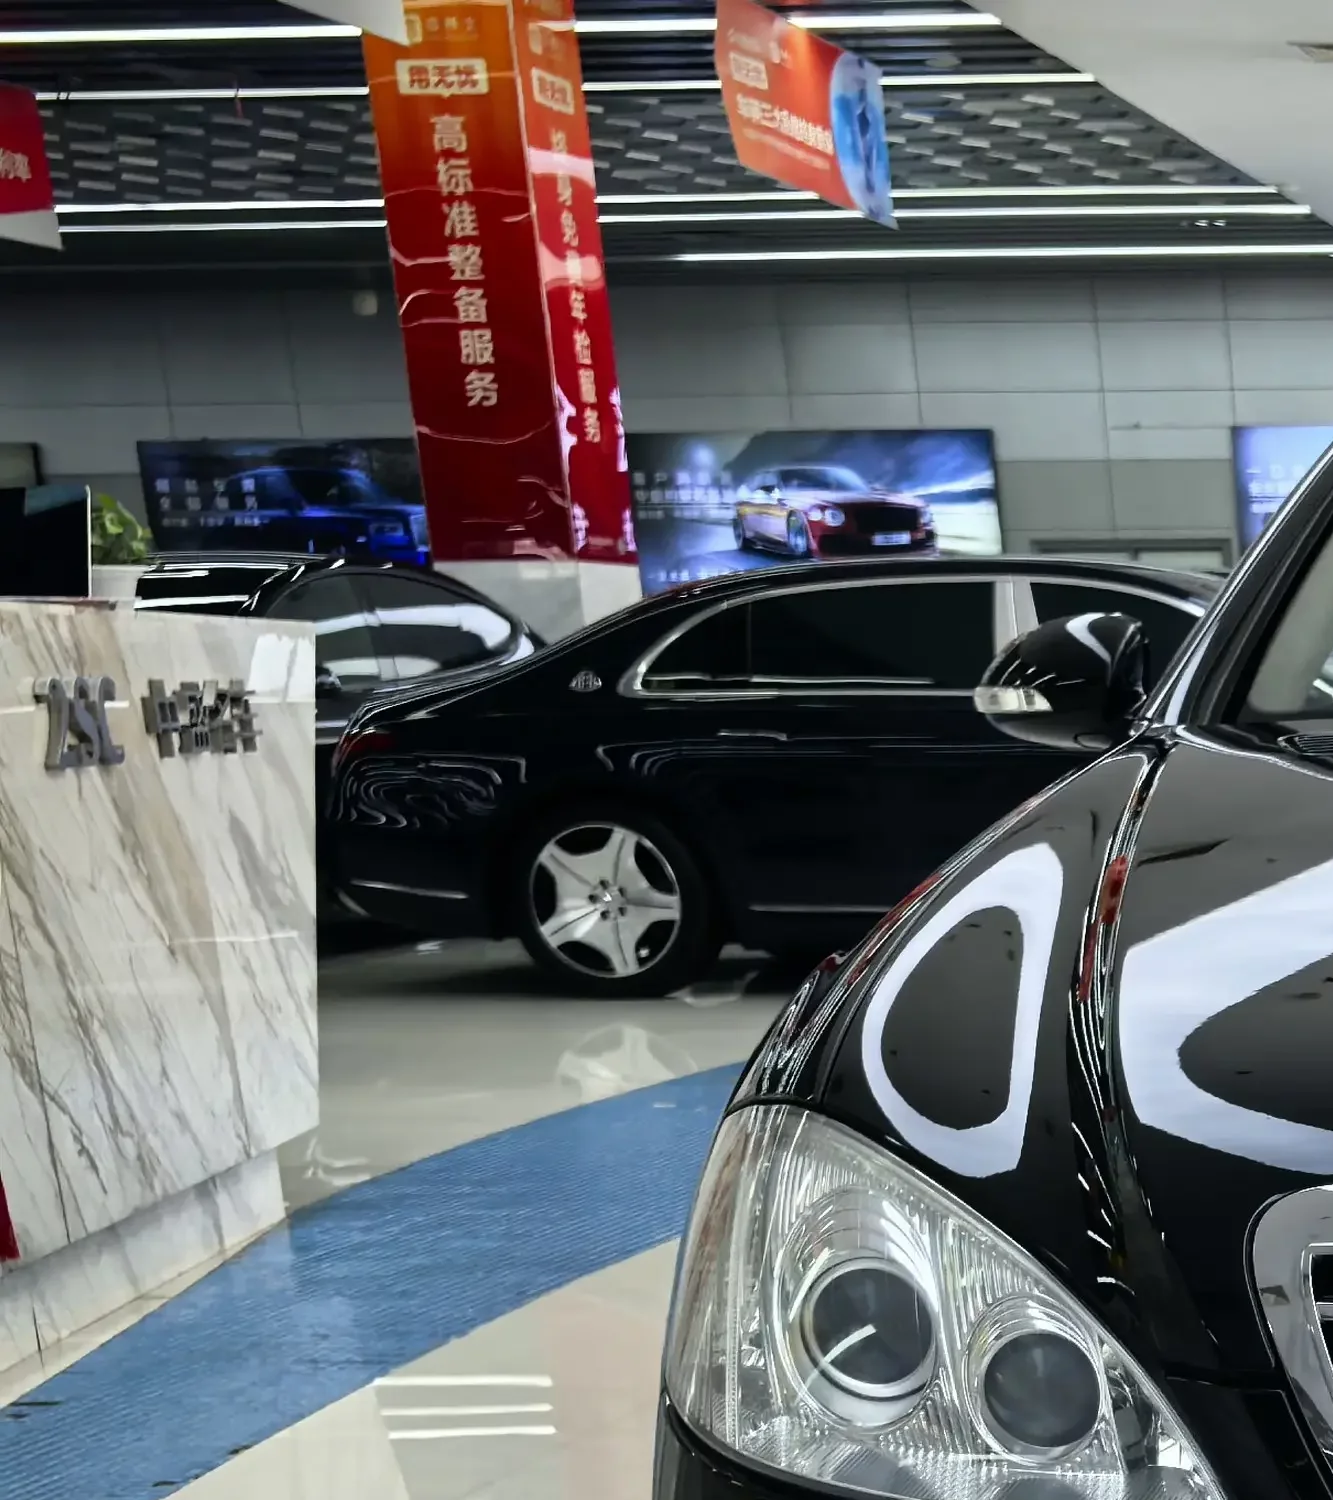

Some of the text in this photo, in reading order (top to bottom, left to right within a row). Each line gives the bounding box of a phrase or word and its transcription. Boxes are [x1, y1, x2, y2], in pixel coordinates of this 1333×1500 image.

[430, 114, 499, 407] 高标准整备服务
